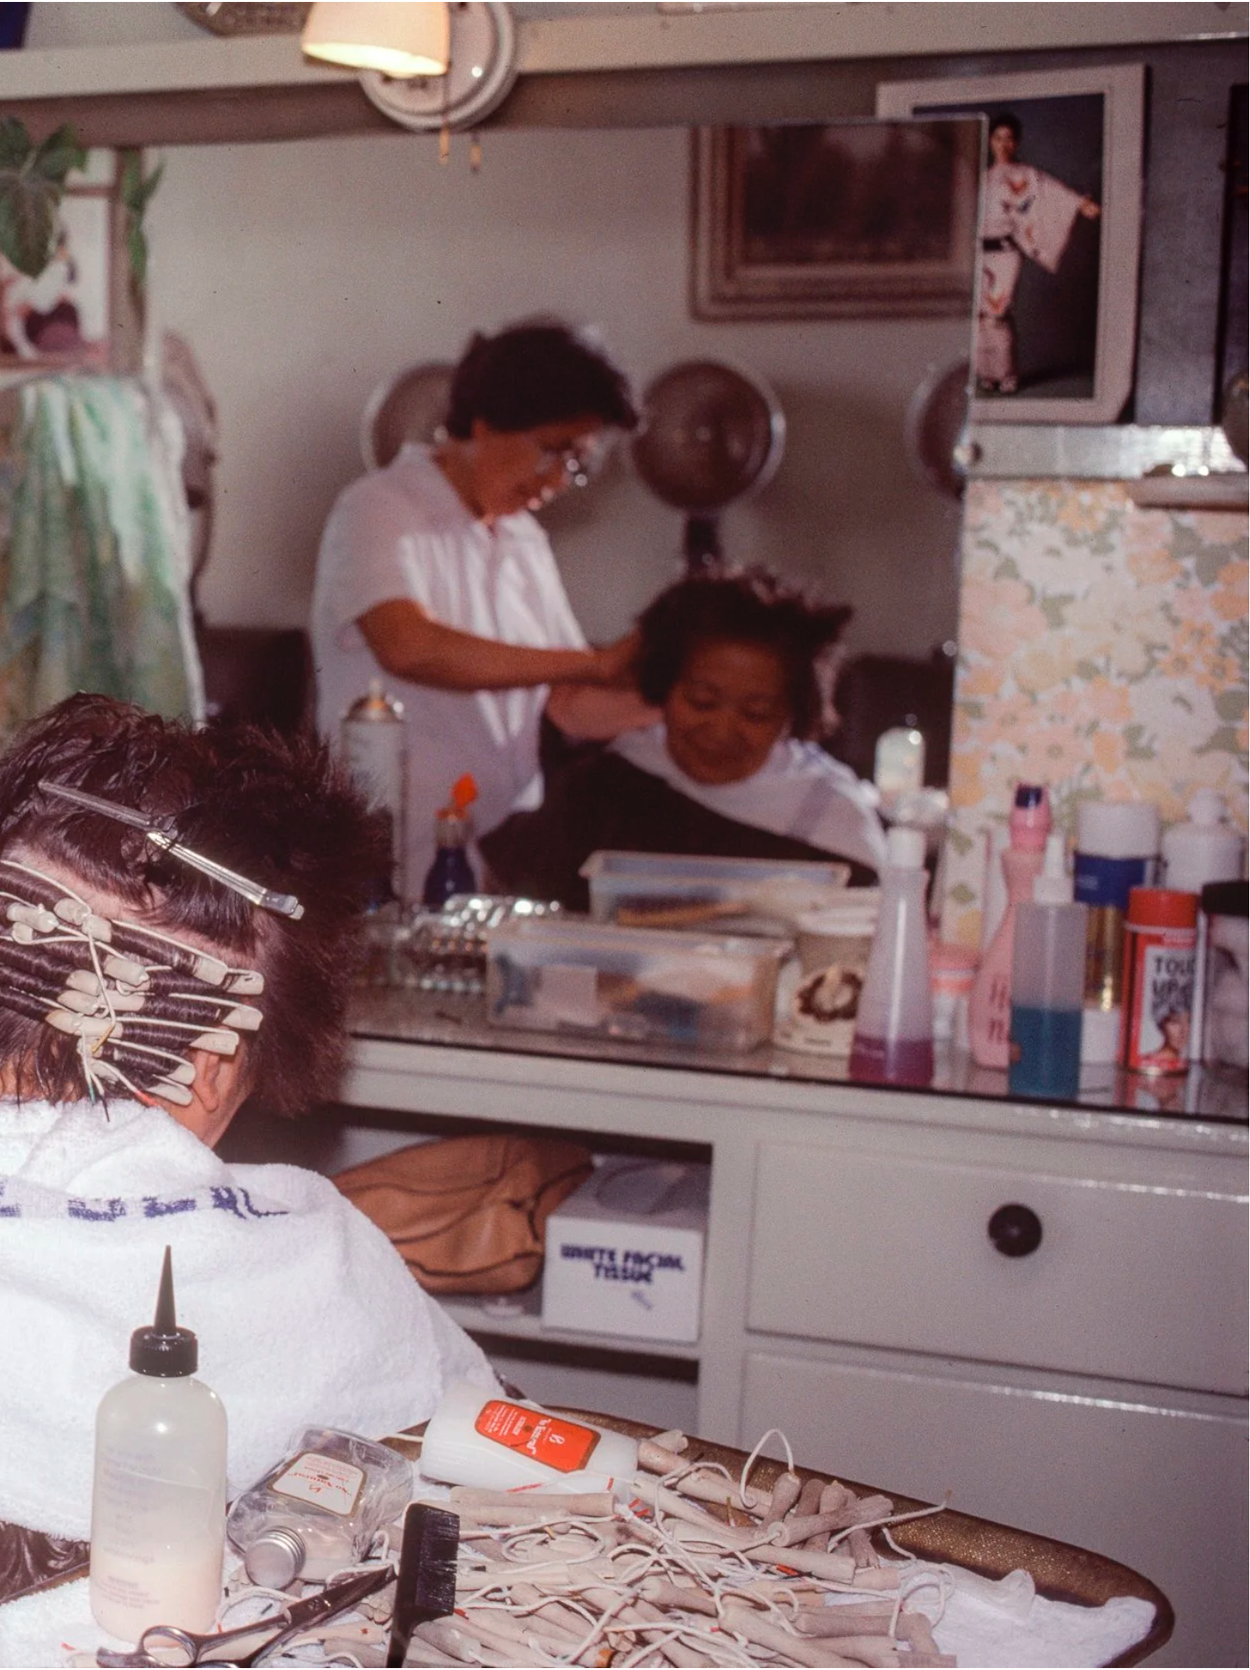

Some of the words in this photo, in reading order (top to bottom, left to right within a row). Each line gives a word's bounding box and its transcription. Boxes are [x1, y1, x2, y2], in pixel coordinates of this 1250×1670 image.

[561, 1243, 616, 1263] WHITE
[622, 1249, 685, 1272] FACIAL
[593, 1263, 652, 1284] TISSUE
